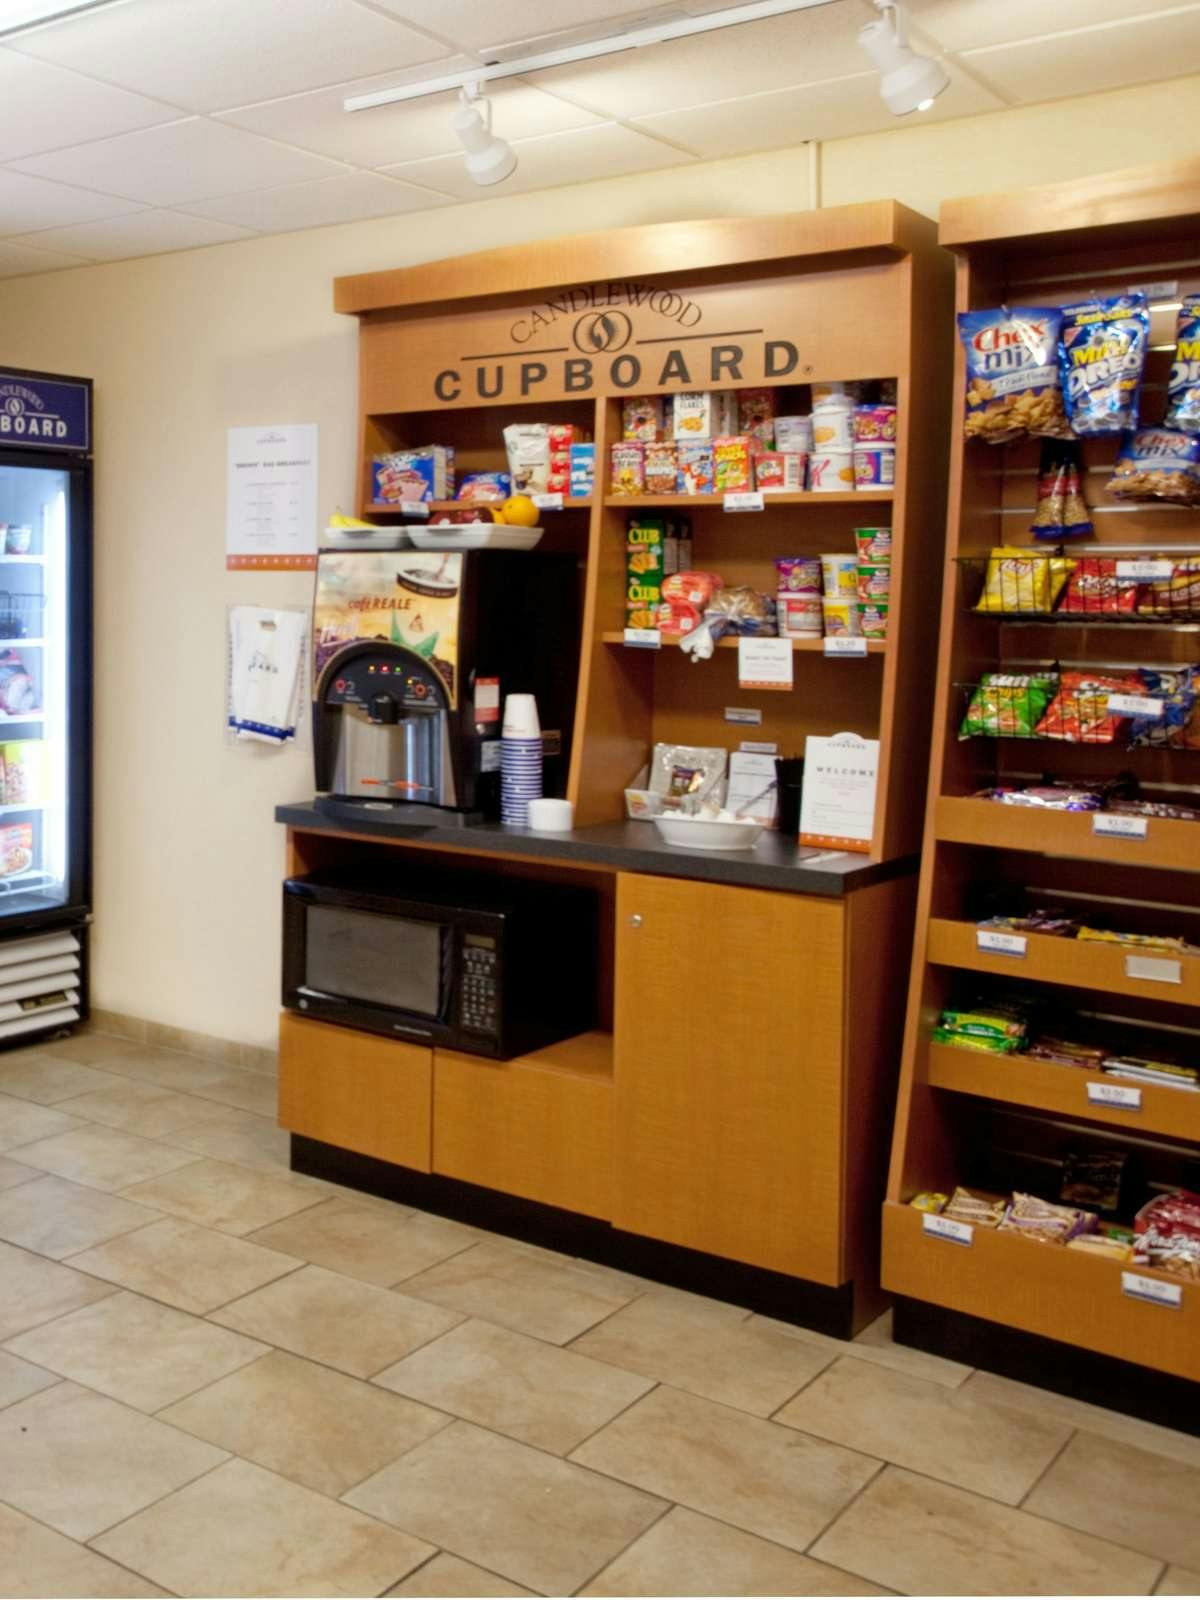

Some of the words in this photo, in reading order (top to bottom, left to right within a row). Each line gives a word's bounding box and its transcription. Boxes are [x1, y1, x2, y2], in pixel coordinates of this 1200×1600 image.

[510, 282, 702, 343] CANDLEWOOD
[434, 340, 799, 402] CUPBOARD
[0, 415, 67, 438] BOARD
